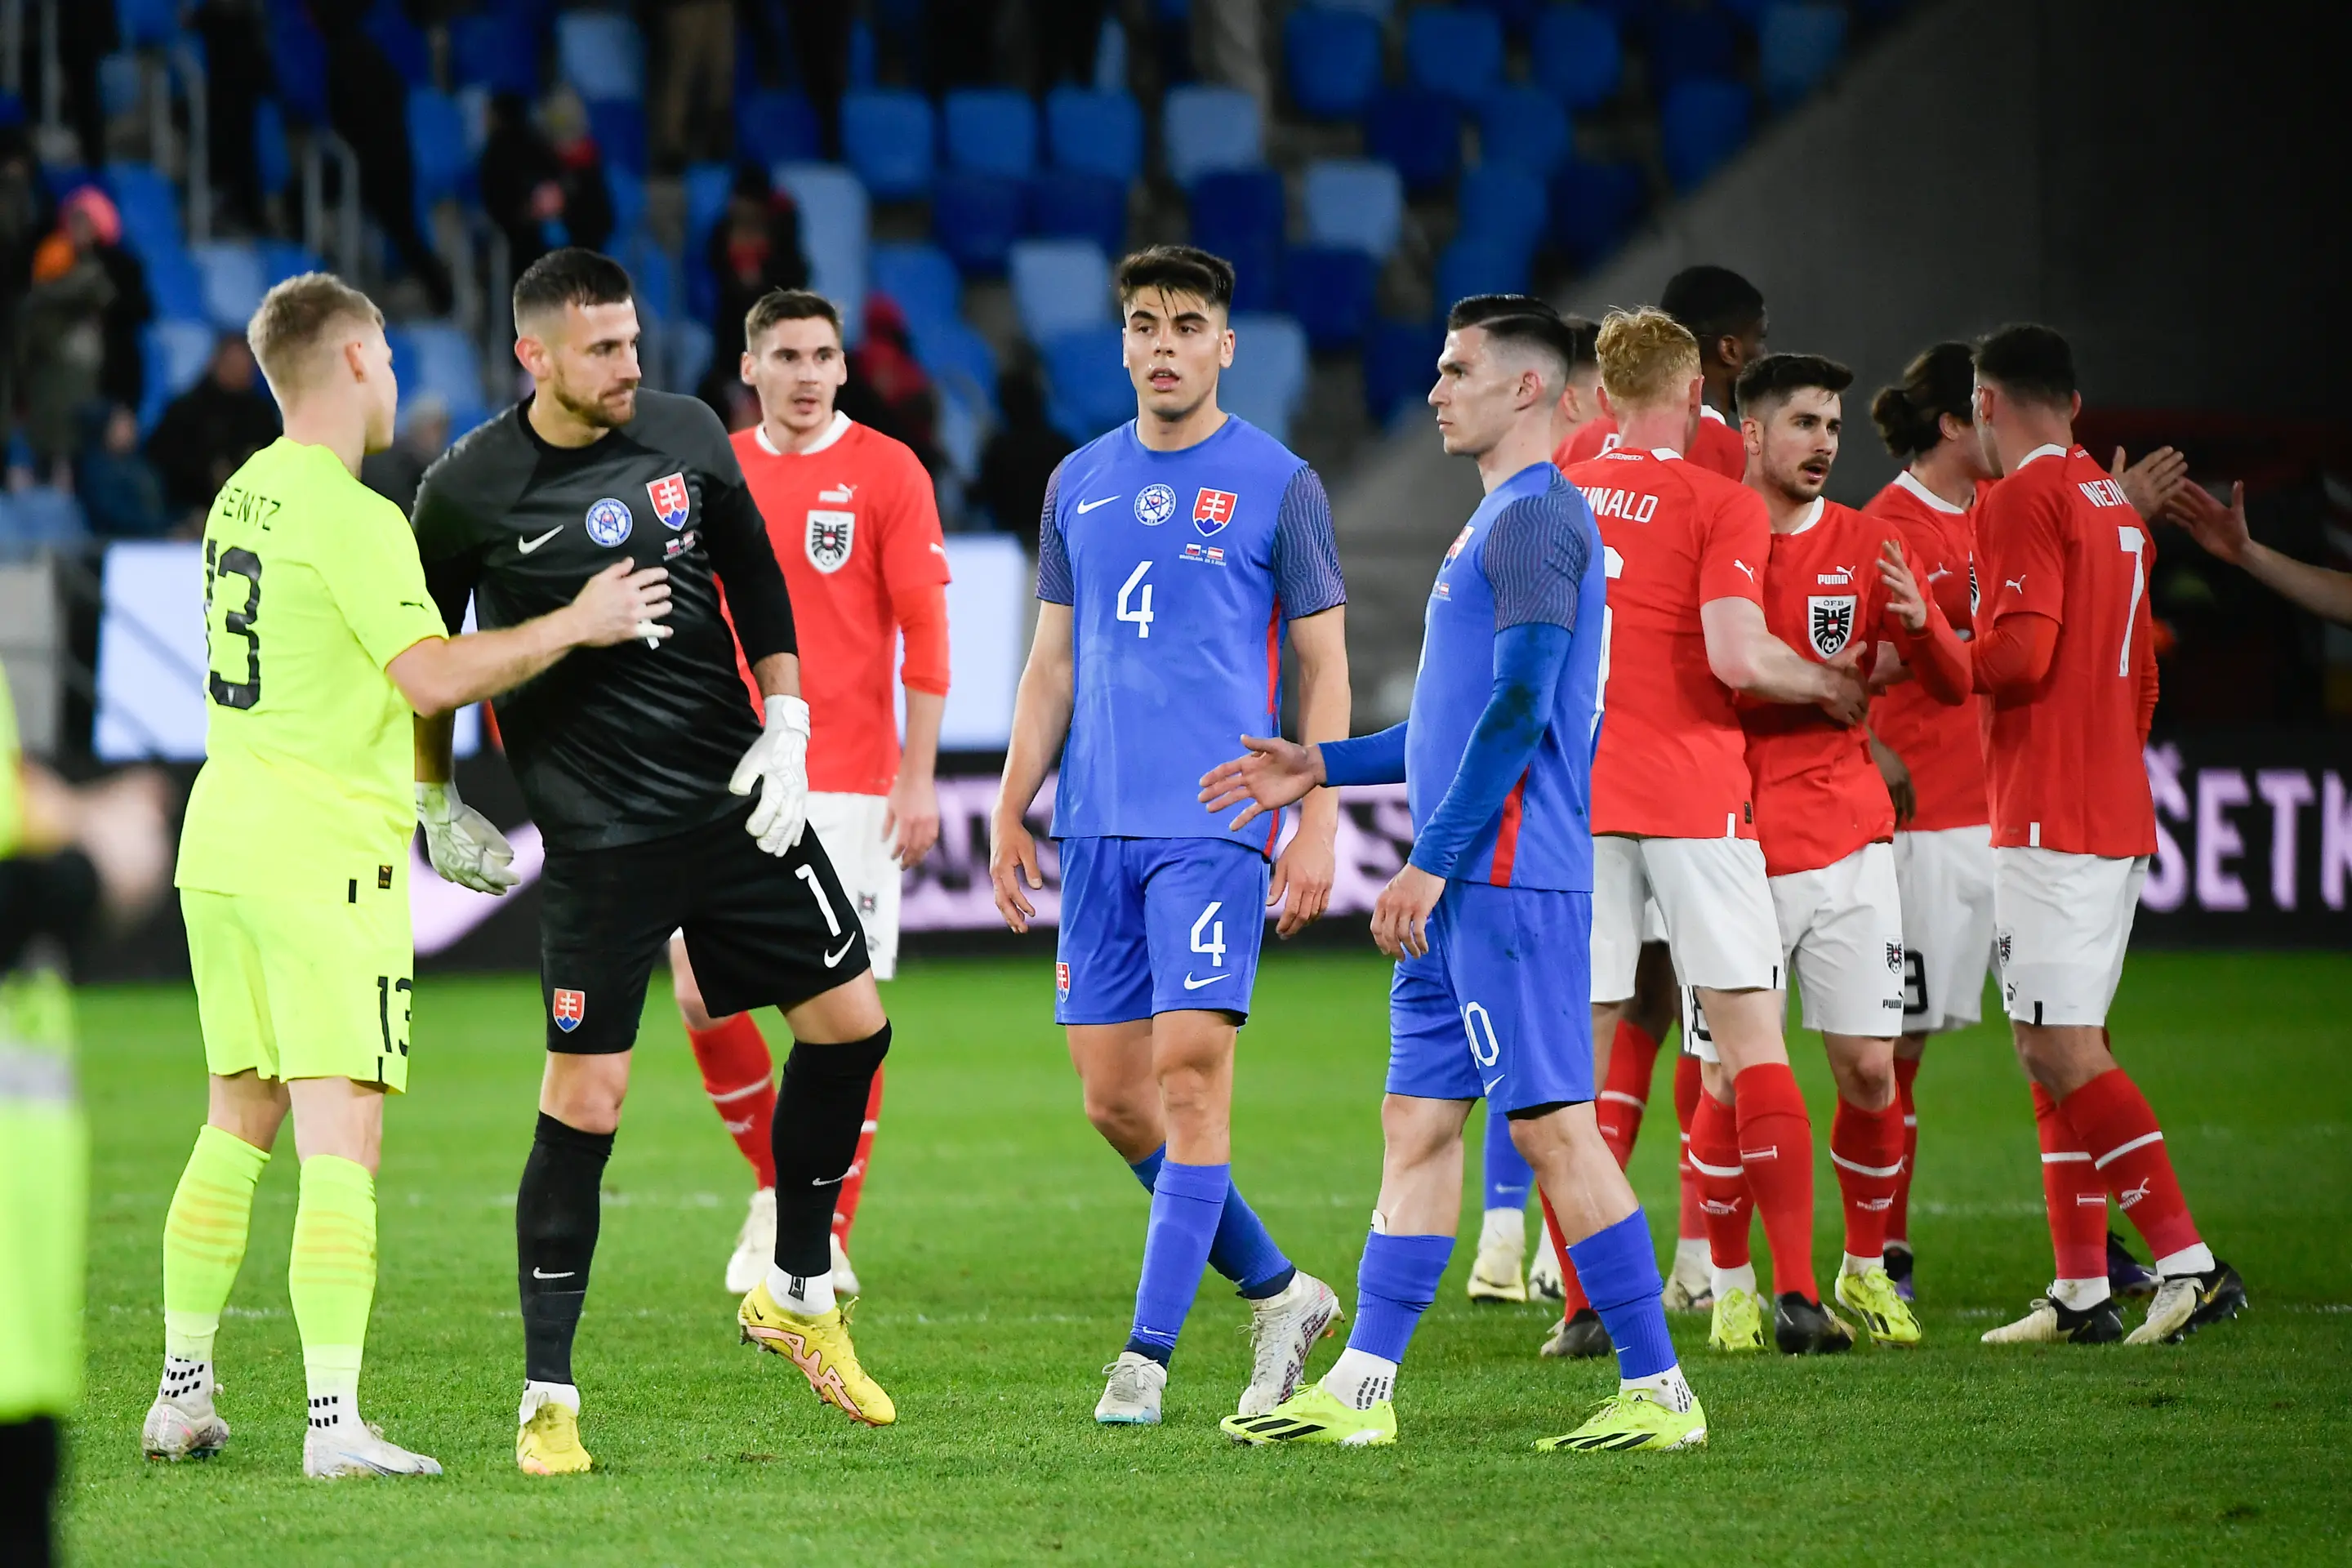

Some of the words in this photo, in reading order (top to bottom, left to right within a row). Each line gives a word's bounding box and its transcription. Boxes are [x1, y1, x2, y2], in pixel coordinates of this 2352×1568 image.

[1575, 487, 1659, 523] WALD
[1116, 560, 1154, 639] 4
[1817, 574, 1848, 585] PUMA
[2118, 525, 2146, 677] 7
[204, 537, 263, 710] 13
[795, 863, 841, 938] 1
[1190, 901, 1227, 967] 4
[376, 976, 412, 1057] 13
